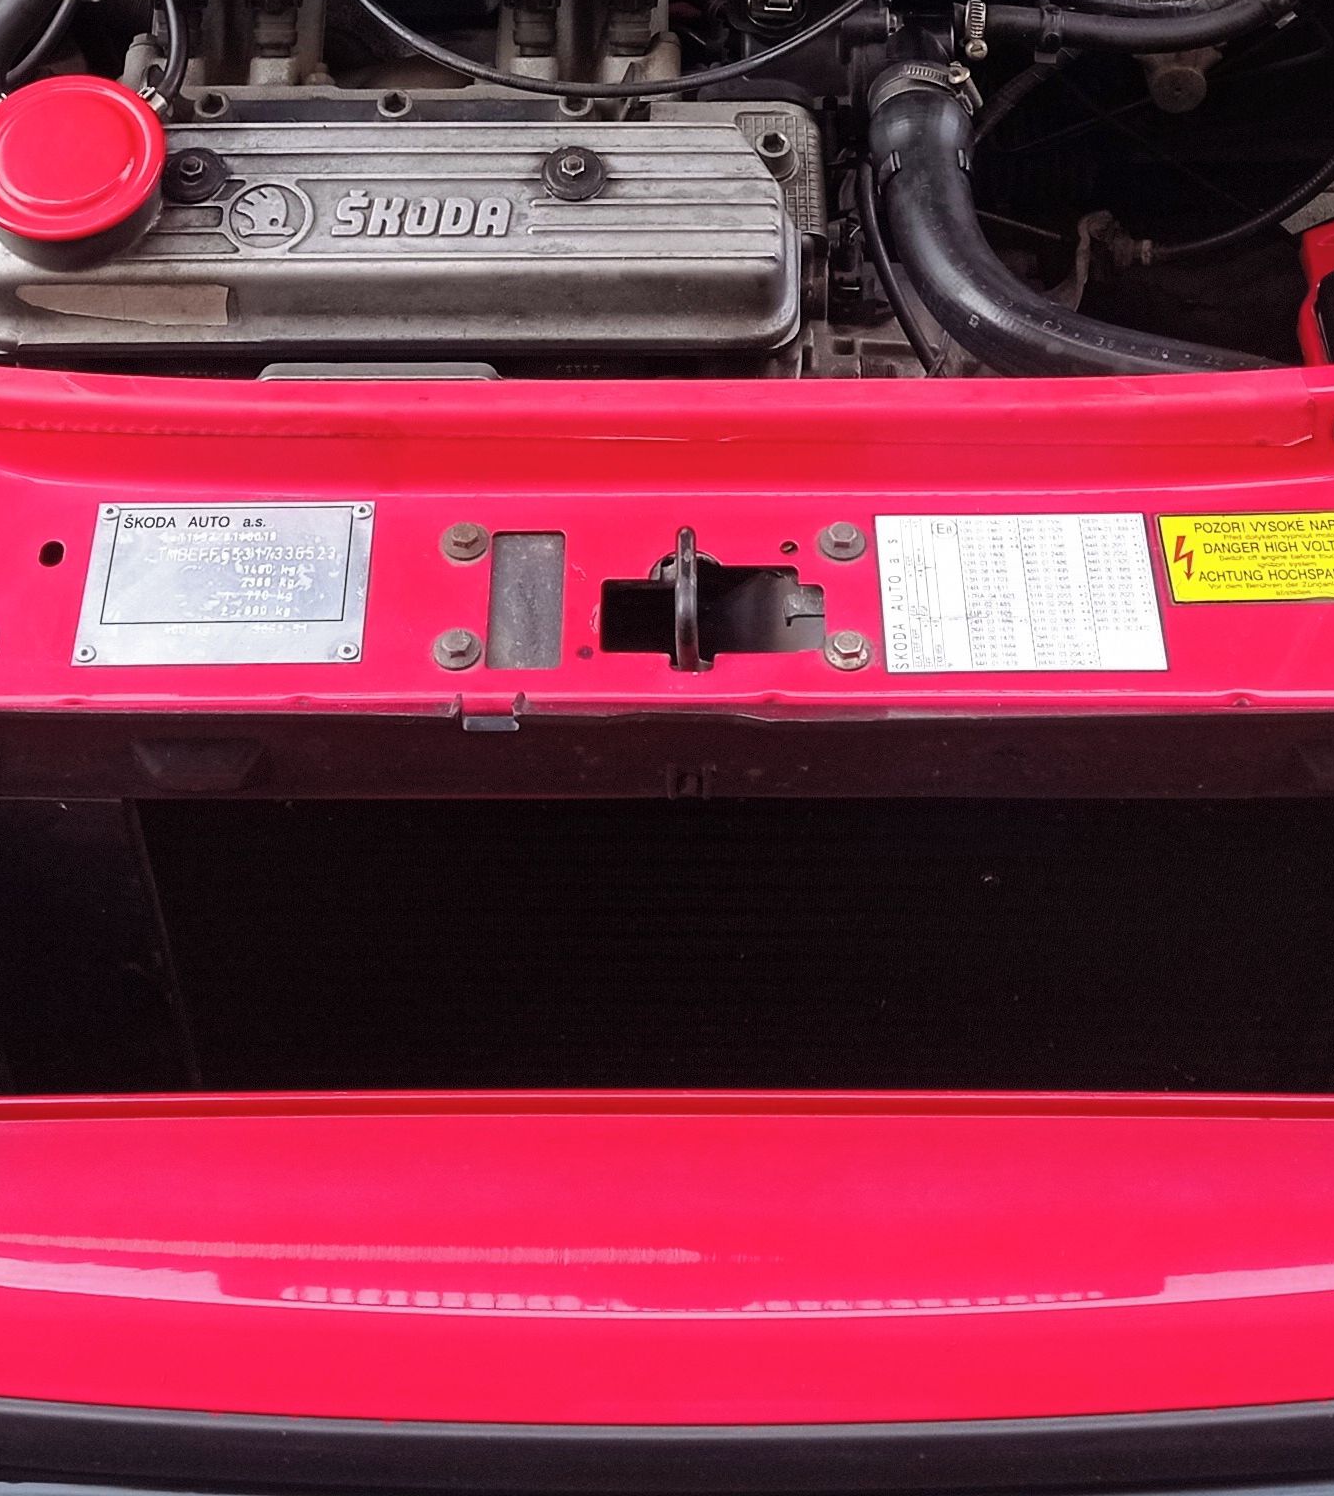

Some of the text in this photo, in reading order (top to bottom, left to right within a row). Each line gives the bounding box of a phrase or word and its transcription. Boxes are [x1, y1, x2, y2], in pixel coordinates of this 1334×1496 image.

[330, 189, 513, 238] ŠKODA
[122, 514, 267, 529] ŠKODA AUTO a.s.
[1250, 517, 1305, 532] VYSOKÉ
[1203, 542, 1260, 554] DANGER
[1264, 541, 1298, 553] HIGH
[1198, 570, 1264, 582] ACHTUNG
[887, 574, 904, 611] AUTO
[892, 622, 910, 670] ŠKODA
